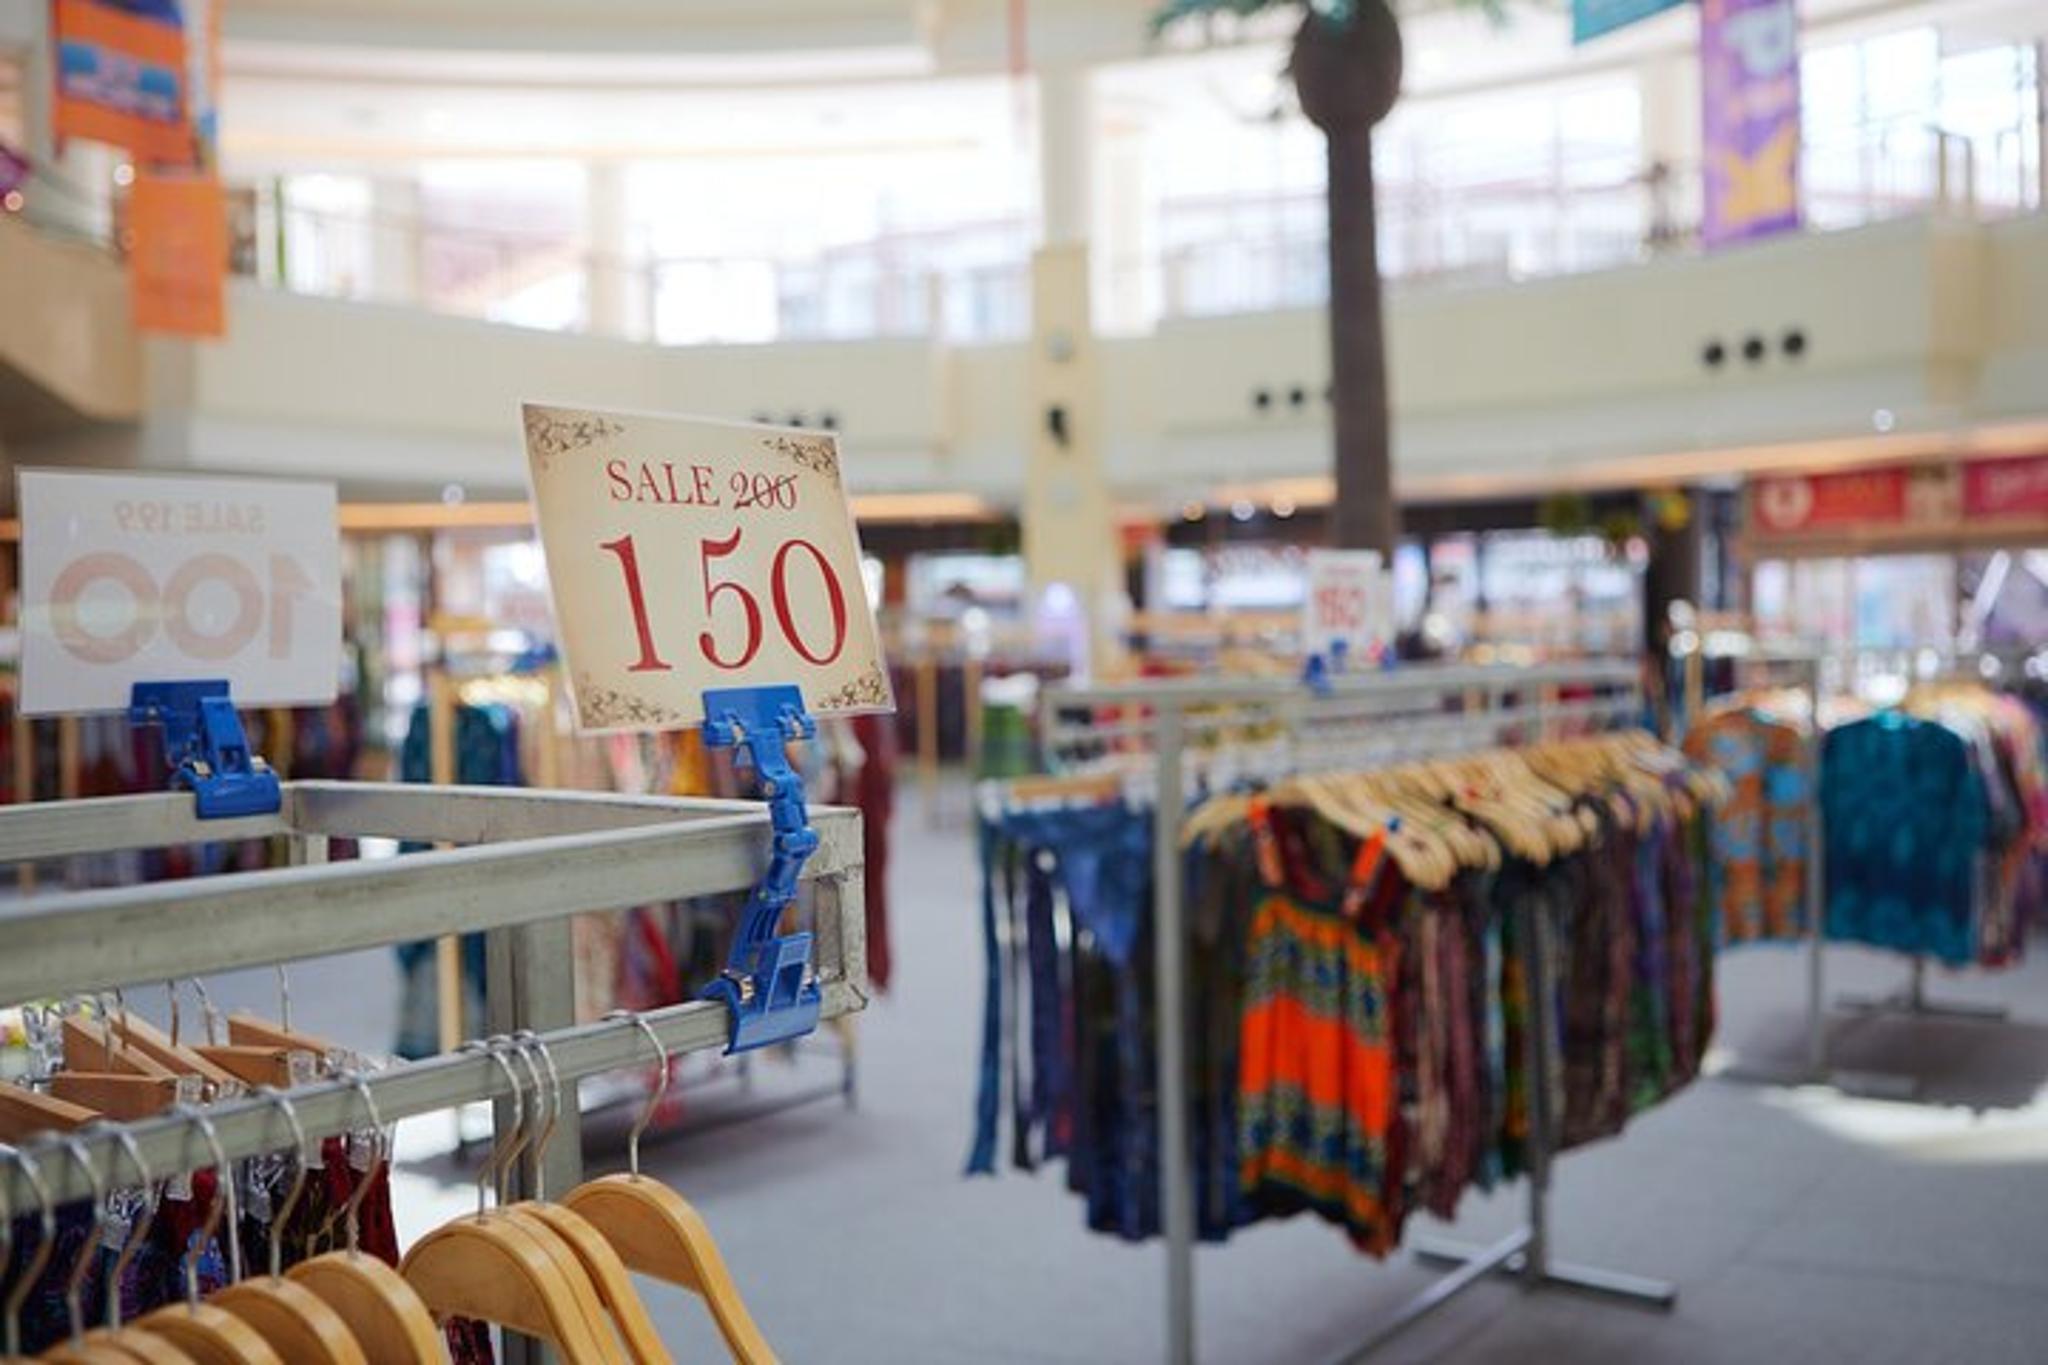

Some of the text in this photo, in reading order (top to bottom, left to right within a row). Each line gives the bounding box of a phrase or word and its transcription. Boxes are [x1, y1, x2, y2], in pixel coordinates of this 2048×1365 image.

[608, 459, 798, 510] SALE 200
[600, 527, 847, 671] 150
